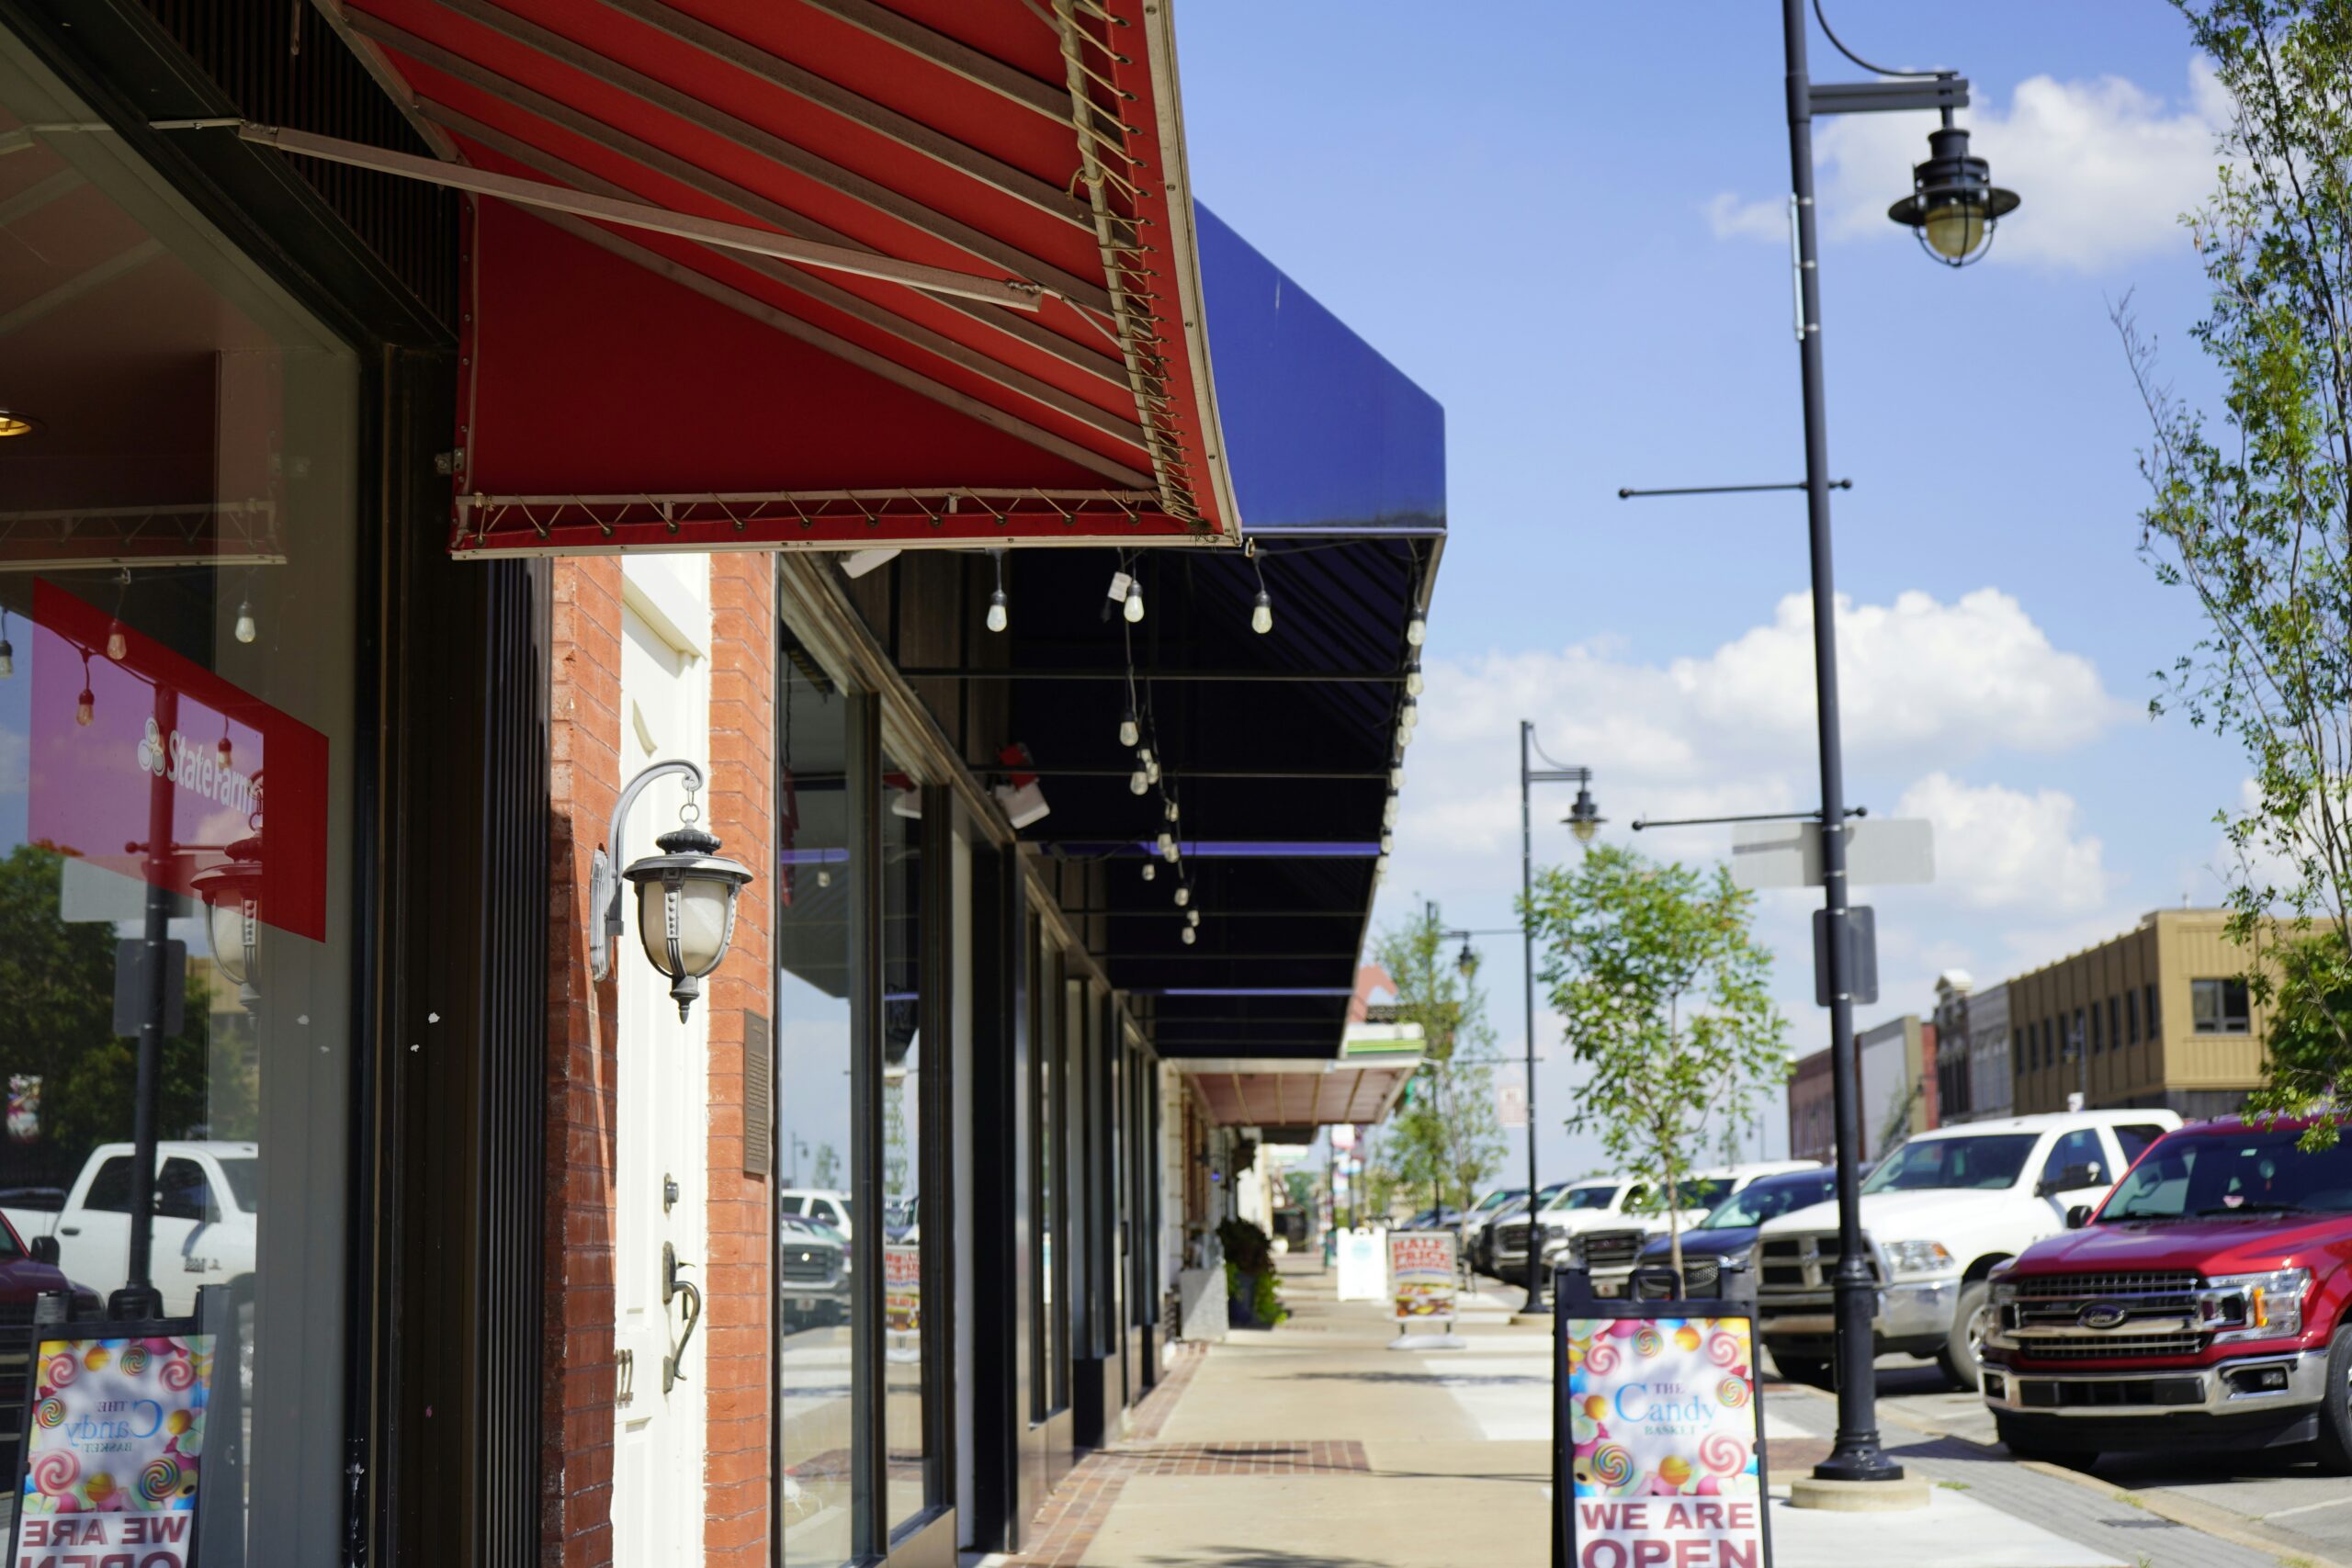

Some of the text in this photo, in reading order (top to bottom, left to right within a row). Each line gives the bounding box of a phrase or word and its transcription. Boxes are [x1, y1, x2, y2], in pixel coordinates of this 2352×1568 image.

[1654, 1382, 1685, 1394] THE
[1614, 1382, 1716, 1428] Candy
[1645, 1426, 1696, 1436] BASKET
[1580, 1503, 1755, 1530] WE ARE
[1582, 1539, 1758, 1568] OPEN
